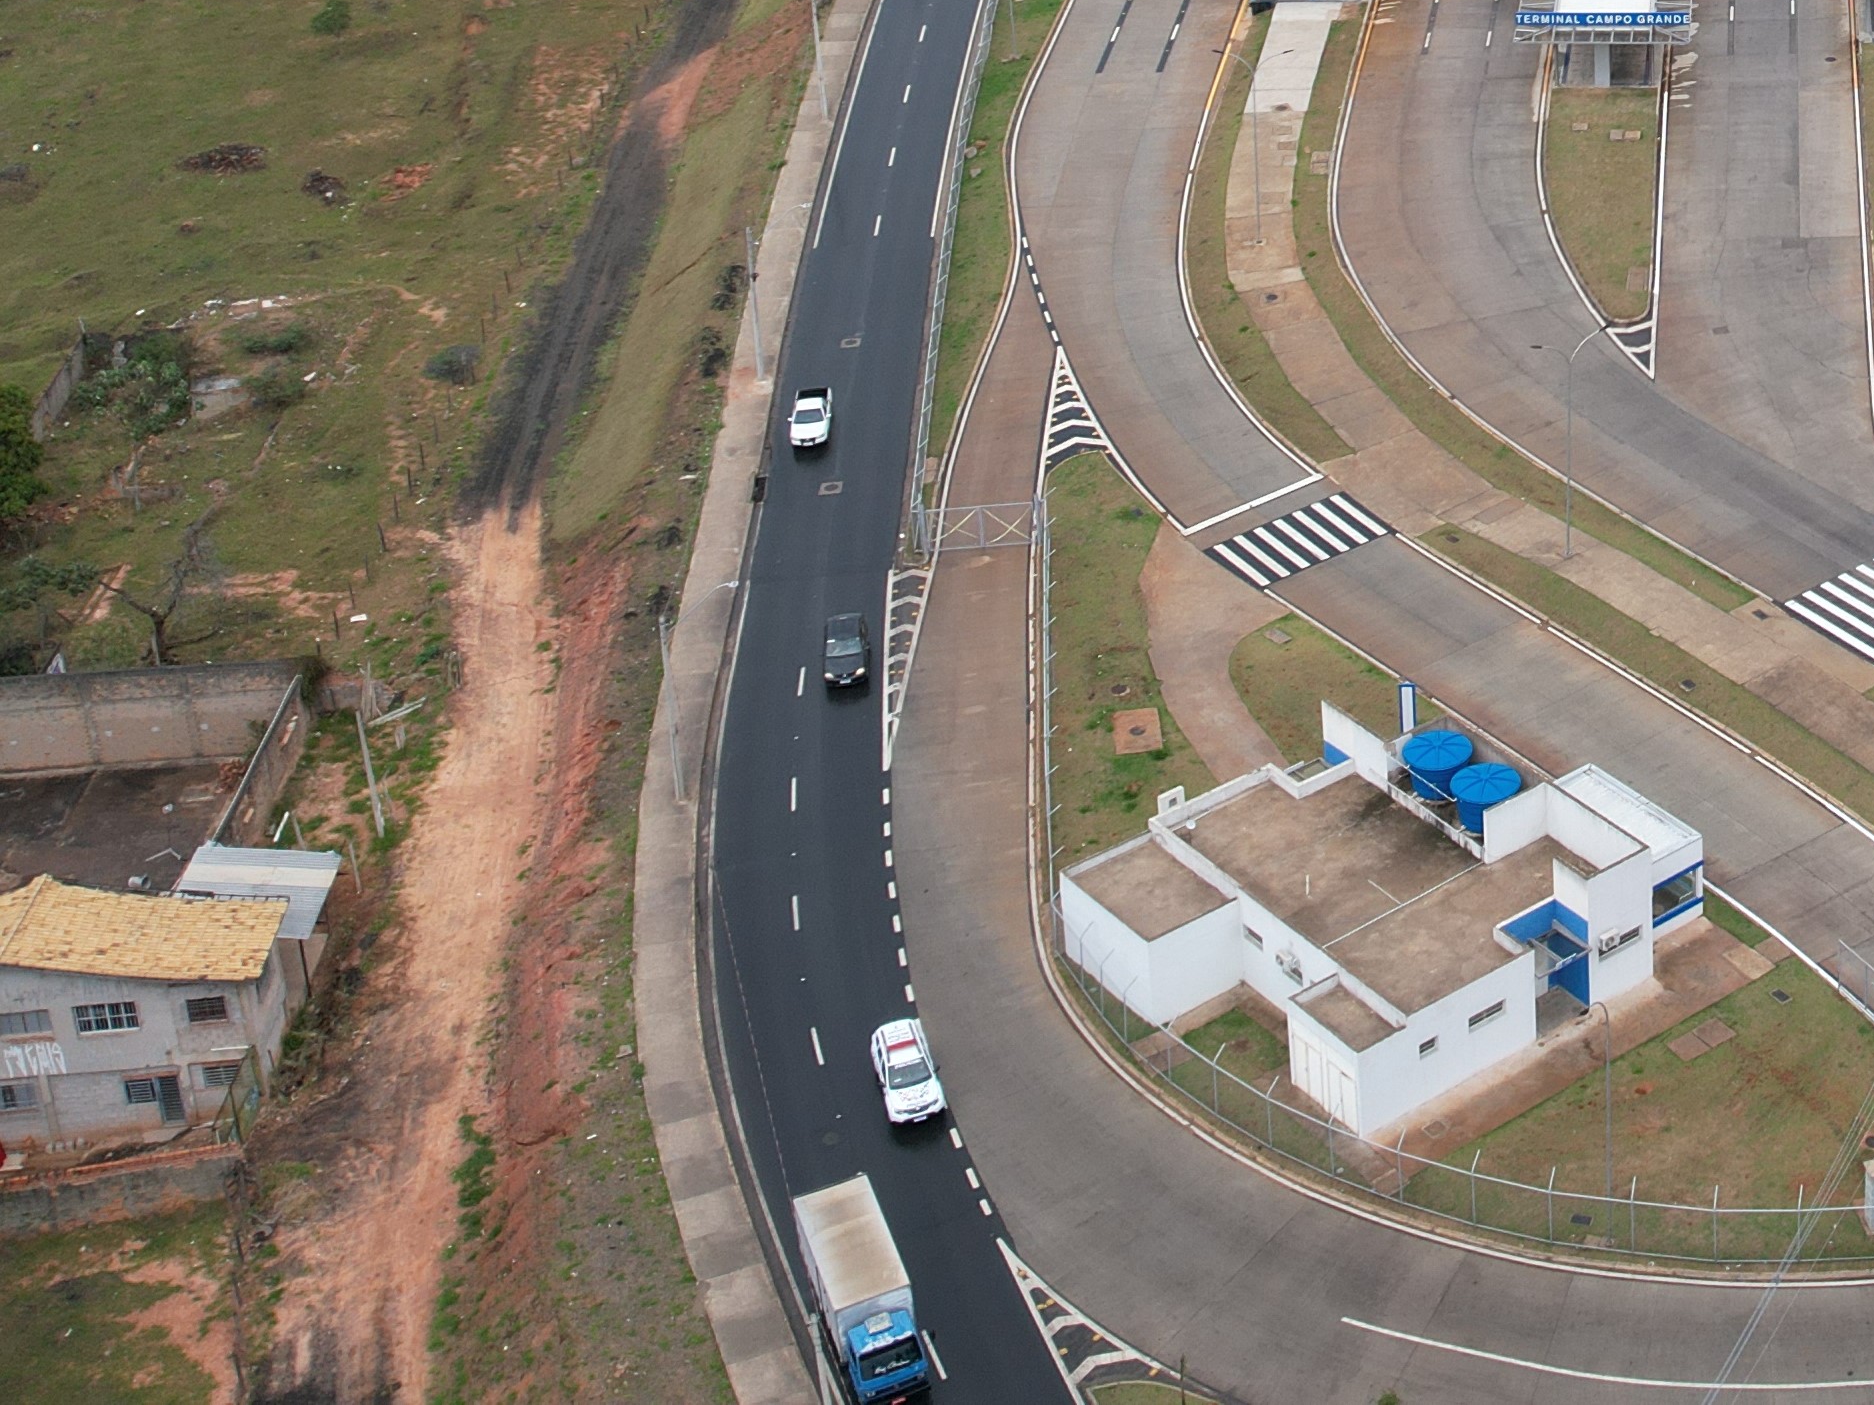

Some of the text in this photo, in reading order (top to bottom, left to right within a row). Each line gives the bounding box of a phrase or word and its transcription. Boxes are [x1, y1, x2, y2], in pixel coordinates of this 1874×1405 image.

[1516, 14, 1690, 24] TERMINAL CAMPO GRANDE
